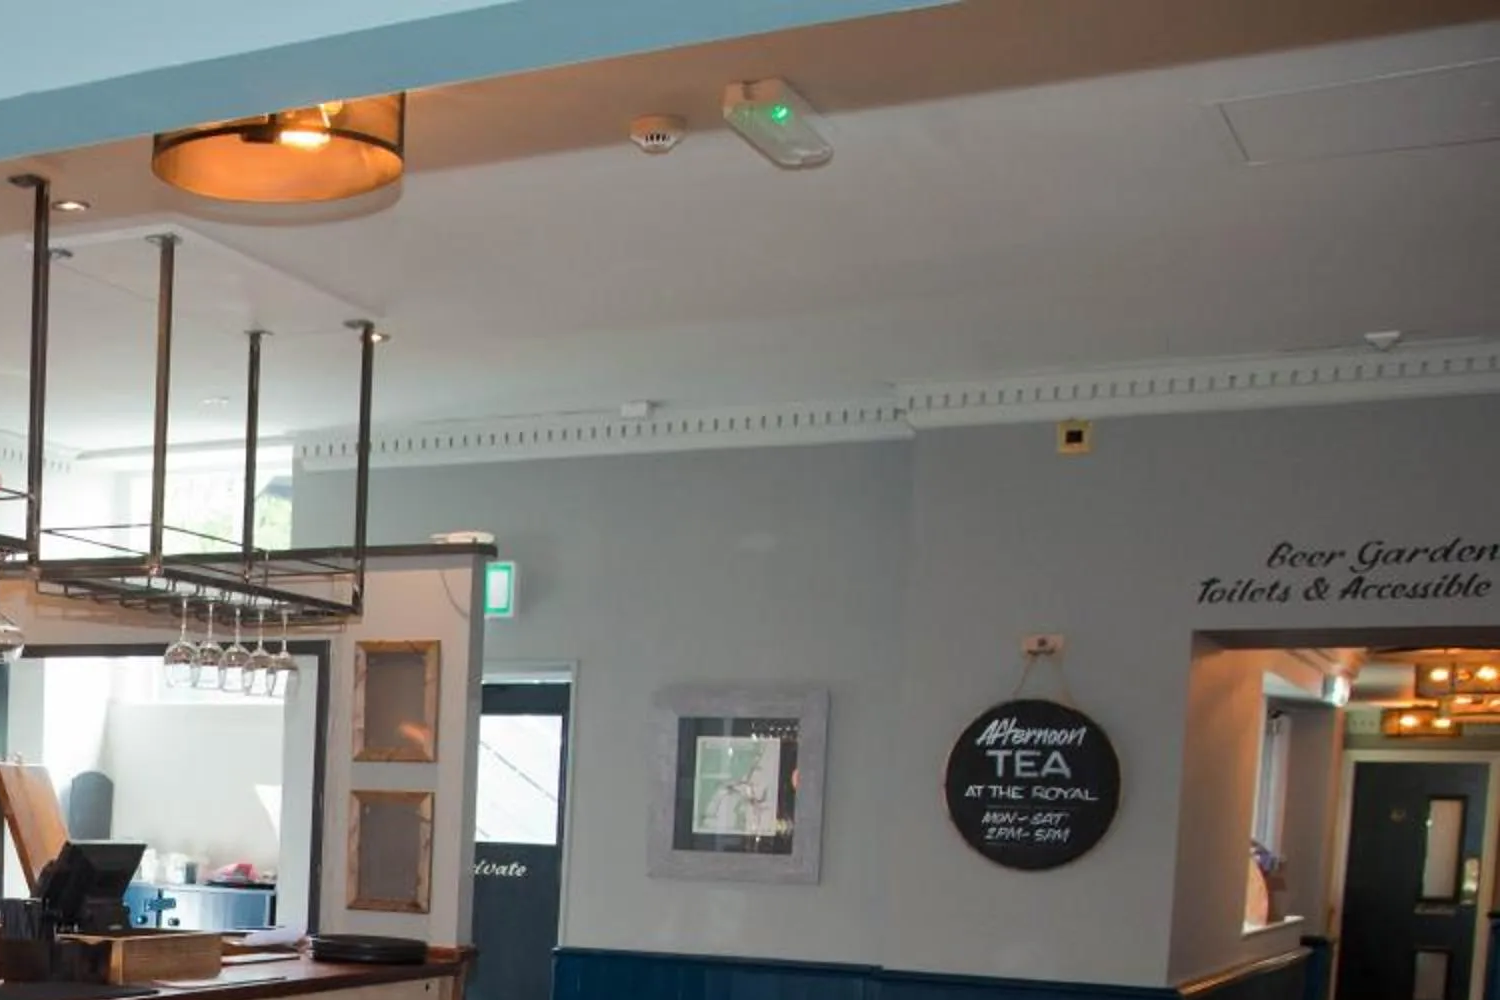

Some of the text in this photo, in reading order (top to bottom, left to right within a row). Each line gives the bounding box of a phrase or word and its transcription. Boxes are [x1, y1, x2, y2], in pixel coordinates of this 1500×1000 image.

[1266, 537, 1500, 574] Beer Garden
[1197, 572, 1492, 605] Toilets & Accessible
[986, 749, 1072, 779] TEA
[964, 784, 1101, 801] AT THE ROYAL
[474, 859, 527, 877] ivate
